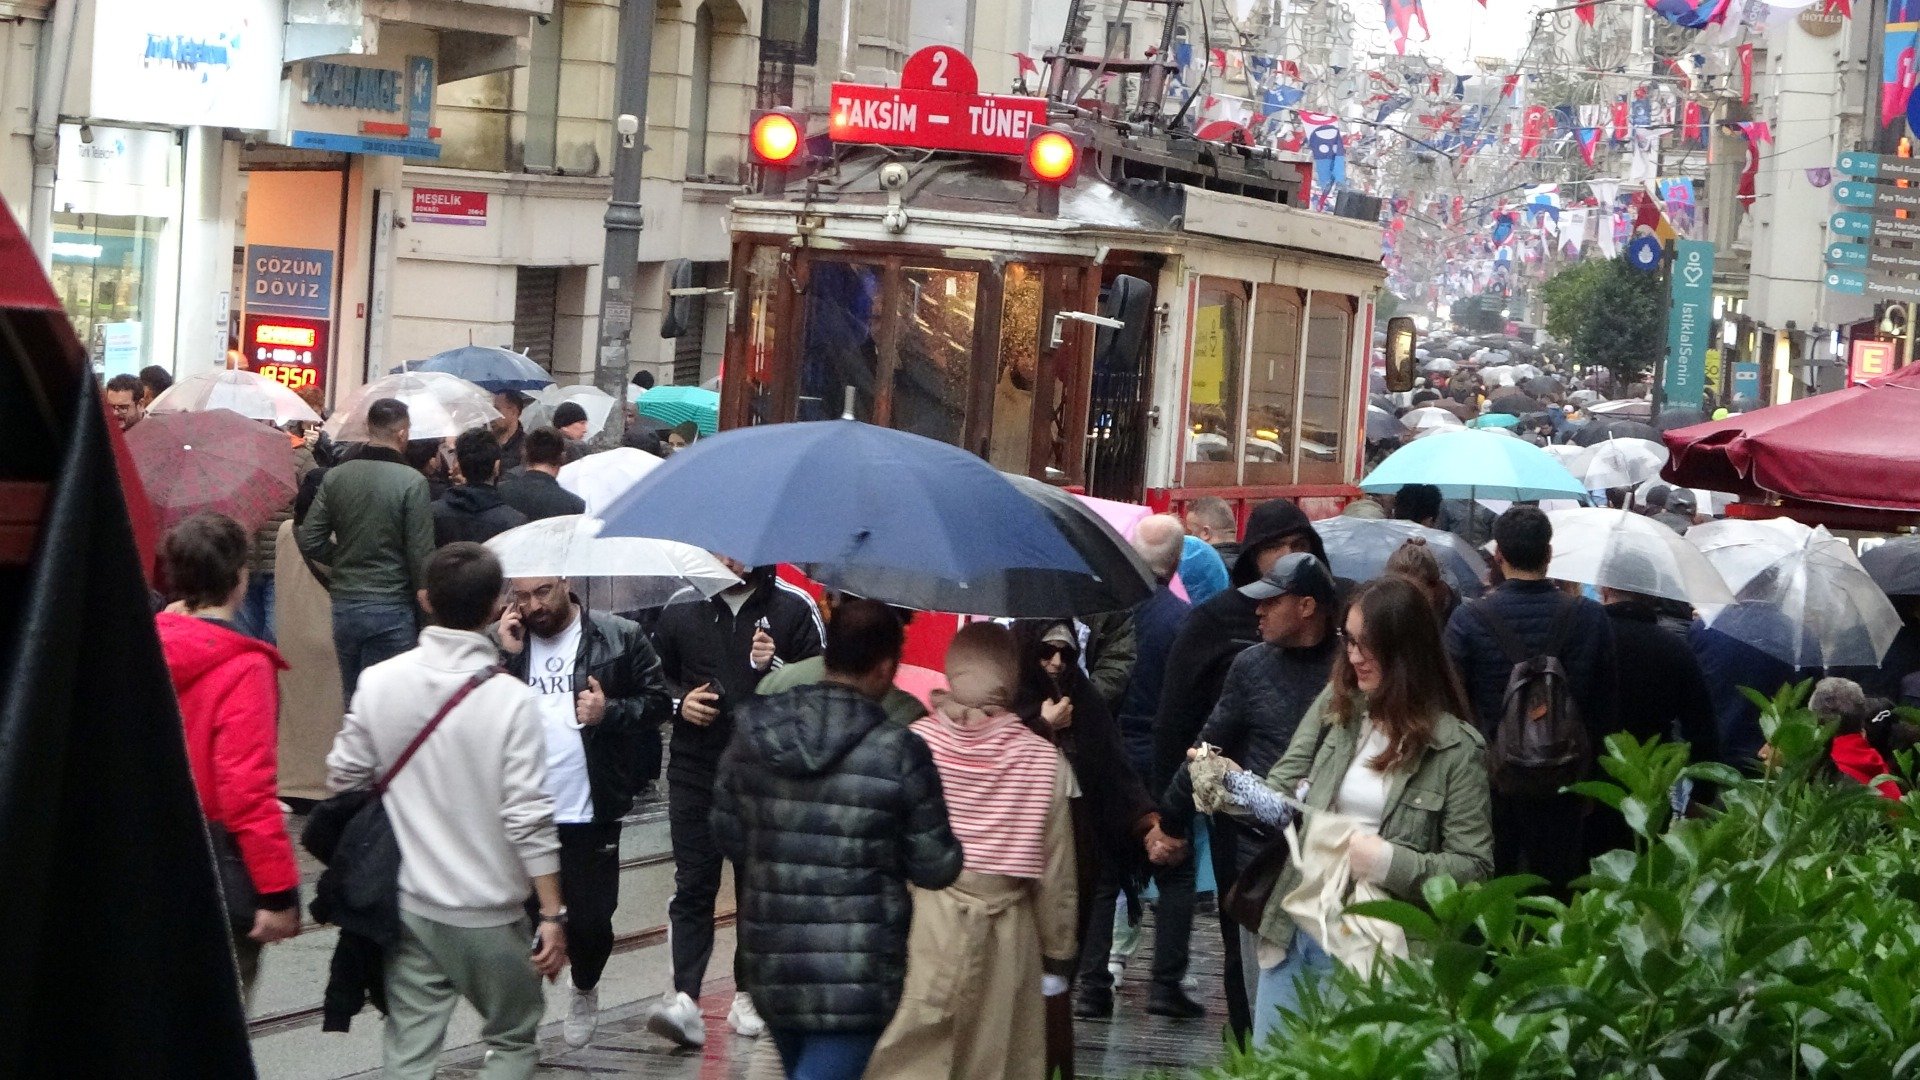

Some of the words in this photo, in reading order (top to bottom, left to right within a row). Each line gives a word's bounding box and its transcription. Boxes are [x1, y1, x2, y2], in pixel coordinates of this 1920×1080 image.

[1802, 13, 1841, 23] HOTELS
[932, 51, 948, 86] 2
[838, 95, 917, 132] TAKSİM
[416, 193, 462, 206] MEŞELİK
[255, 256, 322, 276] ÇÖZÜM
[255, 278, 319, 298] DÖVİZ
[1862, 348, 1885, 373] E
